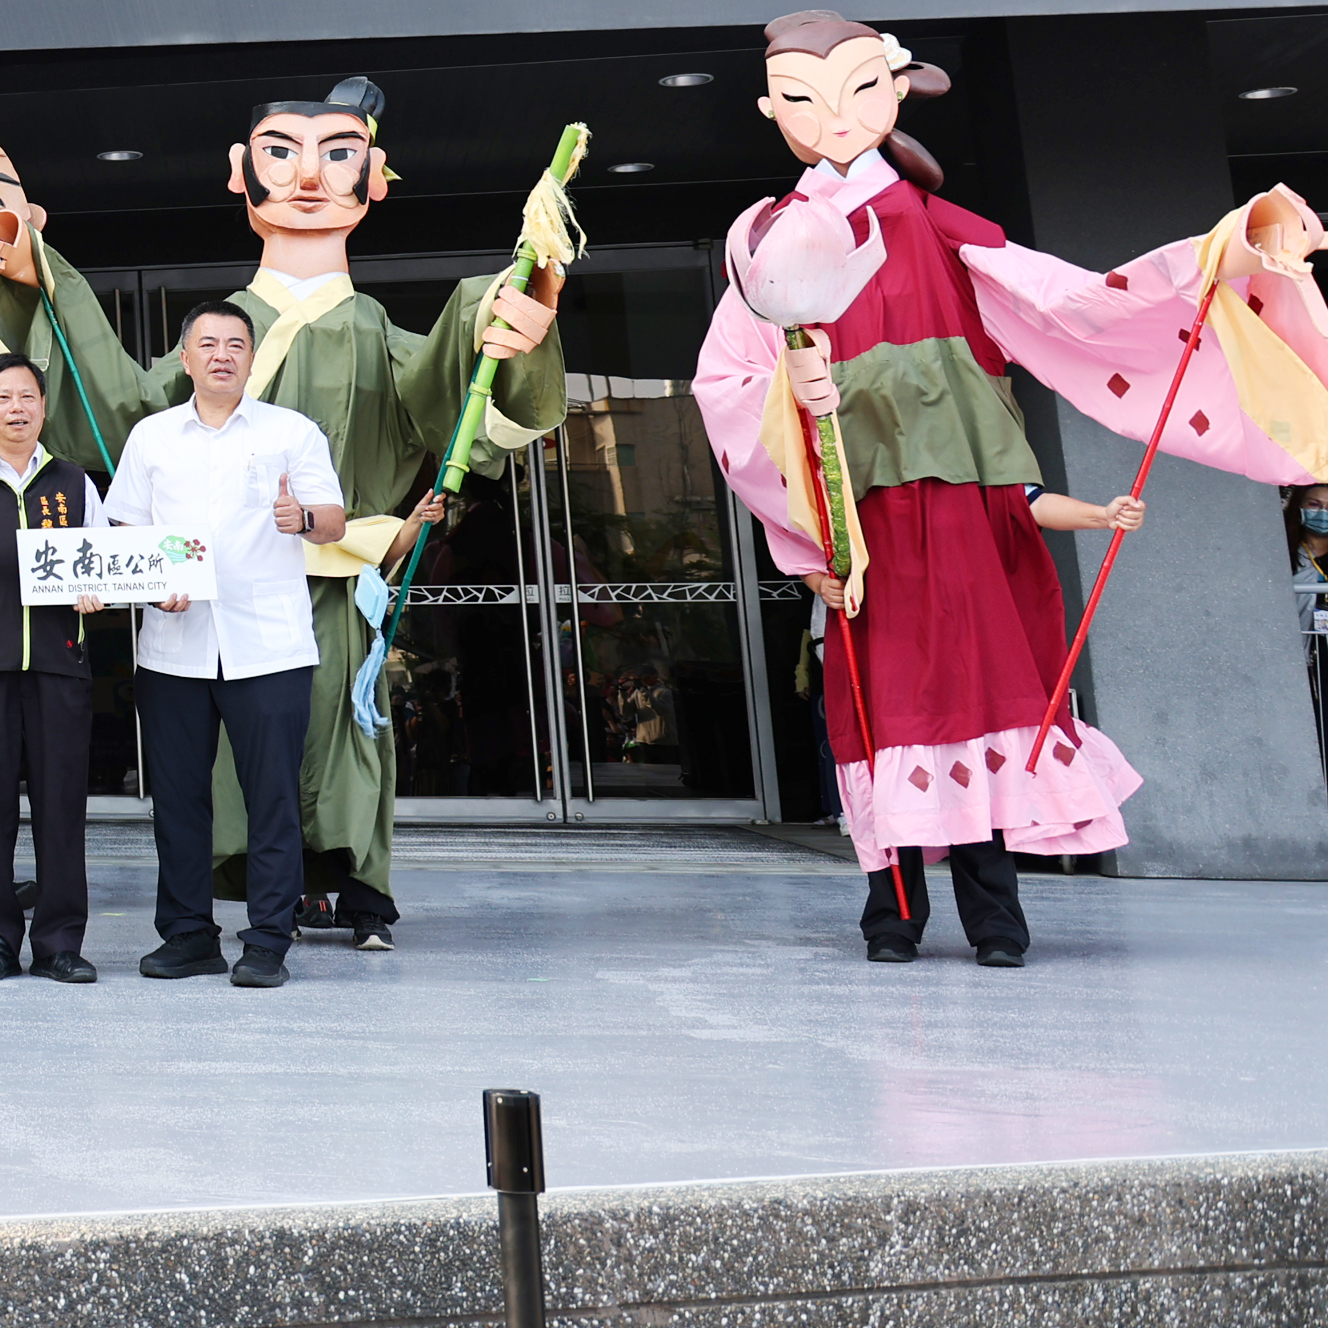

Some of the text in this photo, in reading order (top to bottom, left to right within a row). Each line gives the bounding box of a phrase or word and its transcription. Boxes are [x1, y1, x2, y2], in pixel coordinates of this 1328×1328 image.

[162, 540, 185, 551] 安南
[31, 538, 164, 581] 安南區公所
[32, 581, 167, 593] ANNAN DISTRICT, TAINAN CITY
[559, 586, 571, 596] 拉
